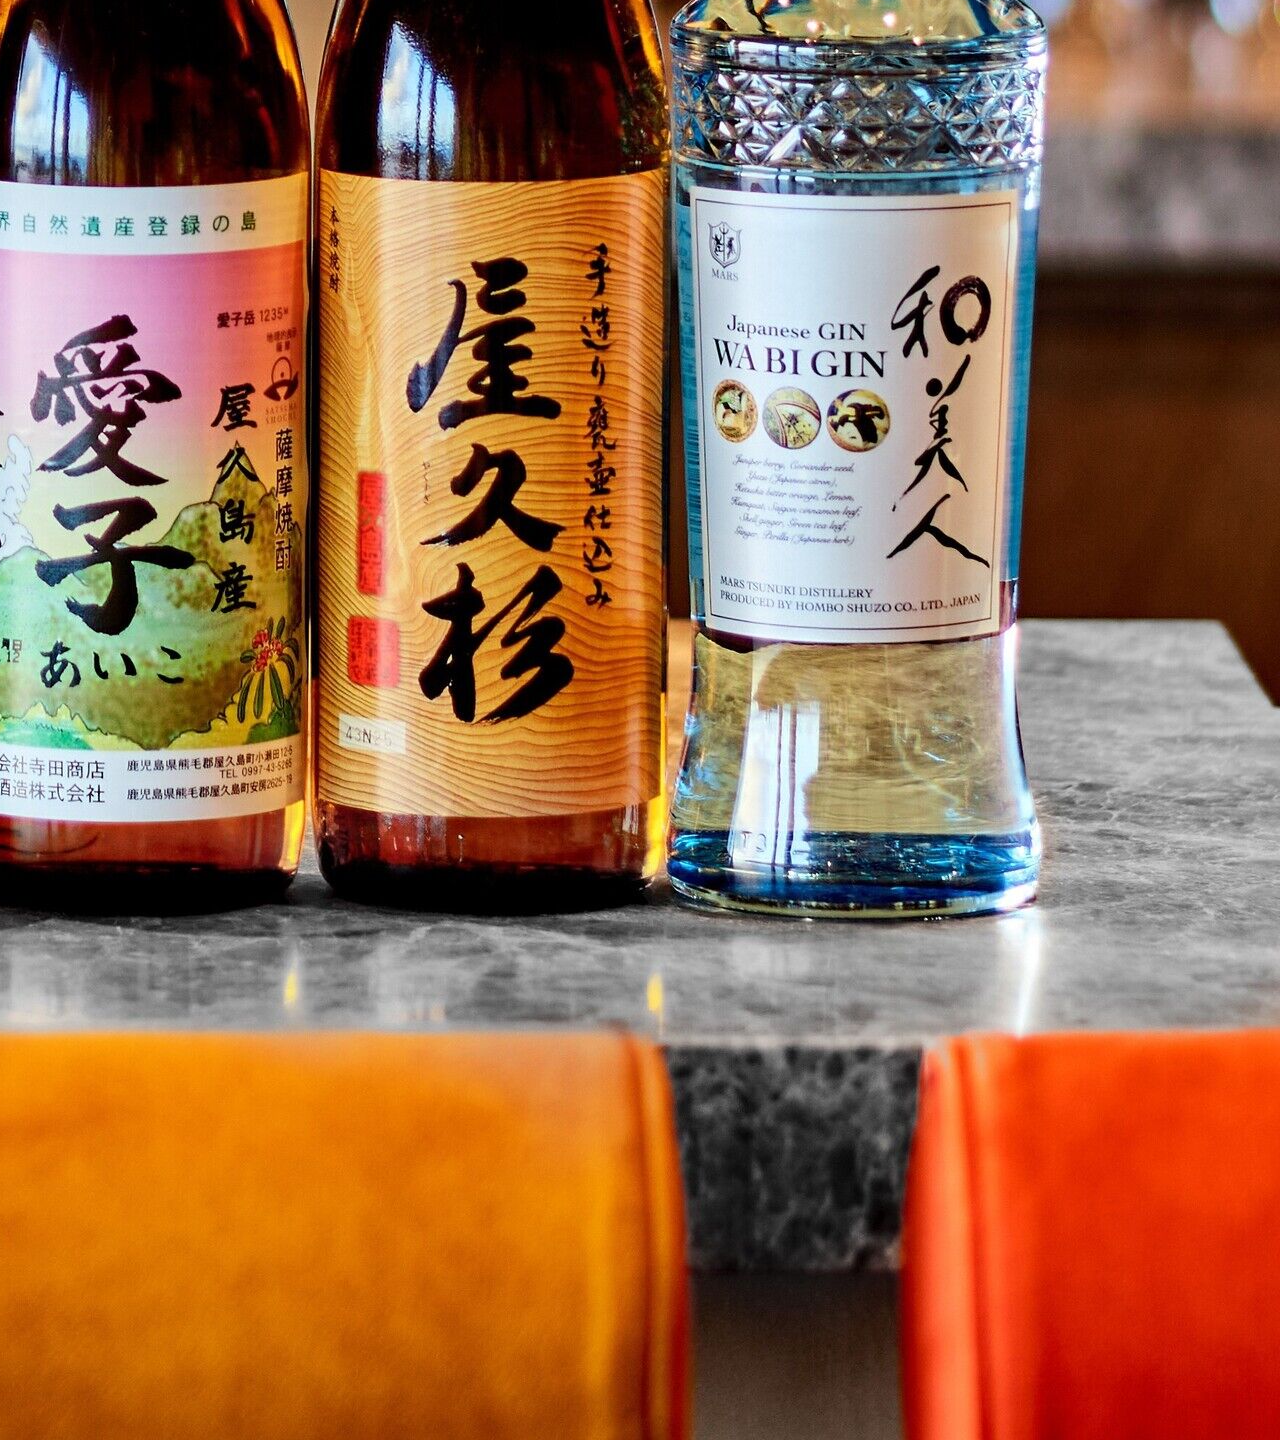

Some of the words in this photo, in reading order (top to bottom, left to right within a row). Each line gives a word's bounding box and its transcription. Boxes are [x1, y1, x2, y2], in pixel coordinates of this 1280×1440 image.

[711, 268, 740, 280] MARS
[216, 309, 256, 328] 愛子岳
[726, 314, 810, 339] Japanese
[818, 322, 868, 341] GIN
[810, 350, 888, 378] GIN
[887, 264, 991, 568] 和美人
[30, 314, 196, 636] 愛子
[211, 383, 258, 614] 屋久島産
[406, 257, 575, 724] 屋久杉
[720, 575, 745, 588] MARS
[746, 581, 796, 595] TSUNUKI
[799, 586, 874, 598] DISTILLERY
[720, 590, 775, 608] PRODUCED
[778, 600, 794, 609] BY
[796, 602, 844, 613] HOMBO
[847, 603, 892, 613] SHUZO
[950, 593, 982, 608] JAPAN
[40, 640, 184, 688] あいこ
[220, 769, 238, 779] TEL
